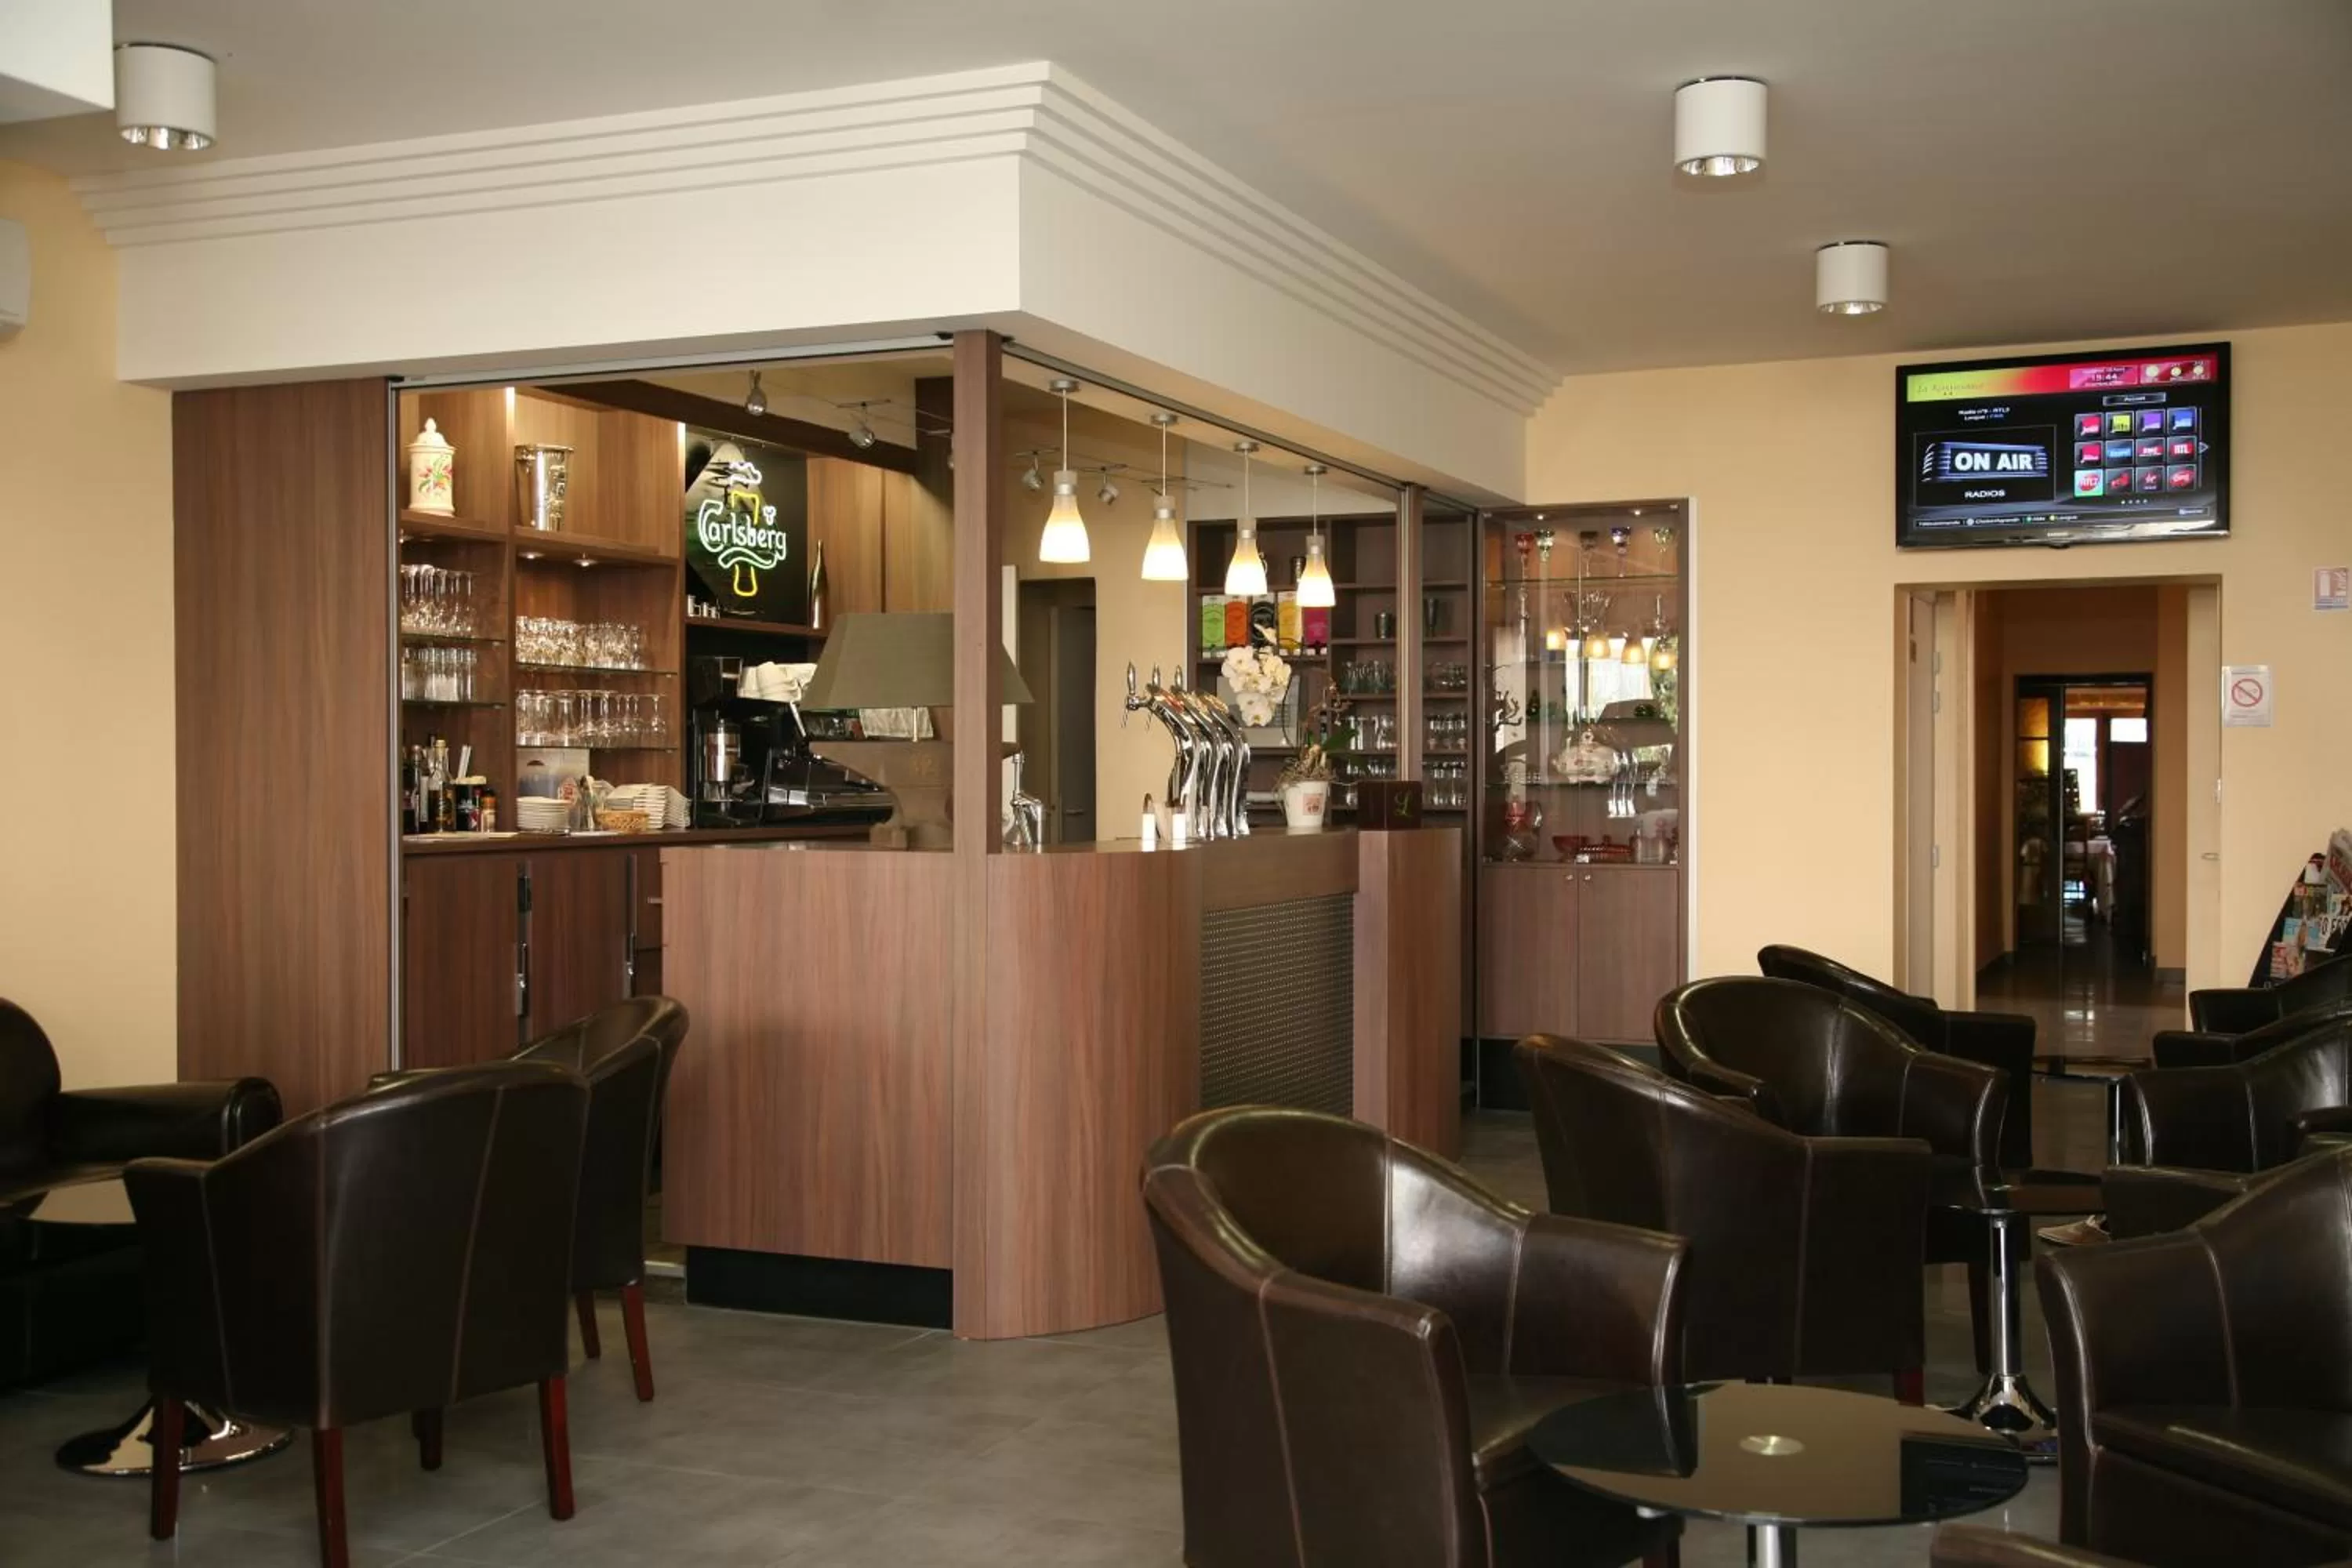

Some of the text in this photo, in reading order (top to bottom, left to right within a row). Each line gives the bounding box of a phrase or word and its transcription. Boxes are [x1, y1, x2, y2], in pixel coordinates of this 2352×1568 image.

[1955, 452, 2033, 471] ON AIR
[1964, 488, 2006, 499] RADIOS
[698, 499, 787, 561] Carlsberg
